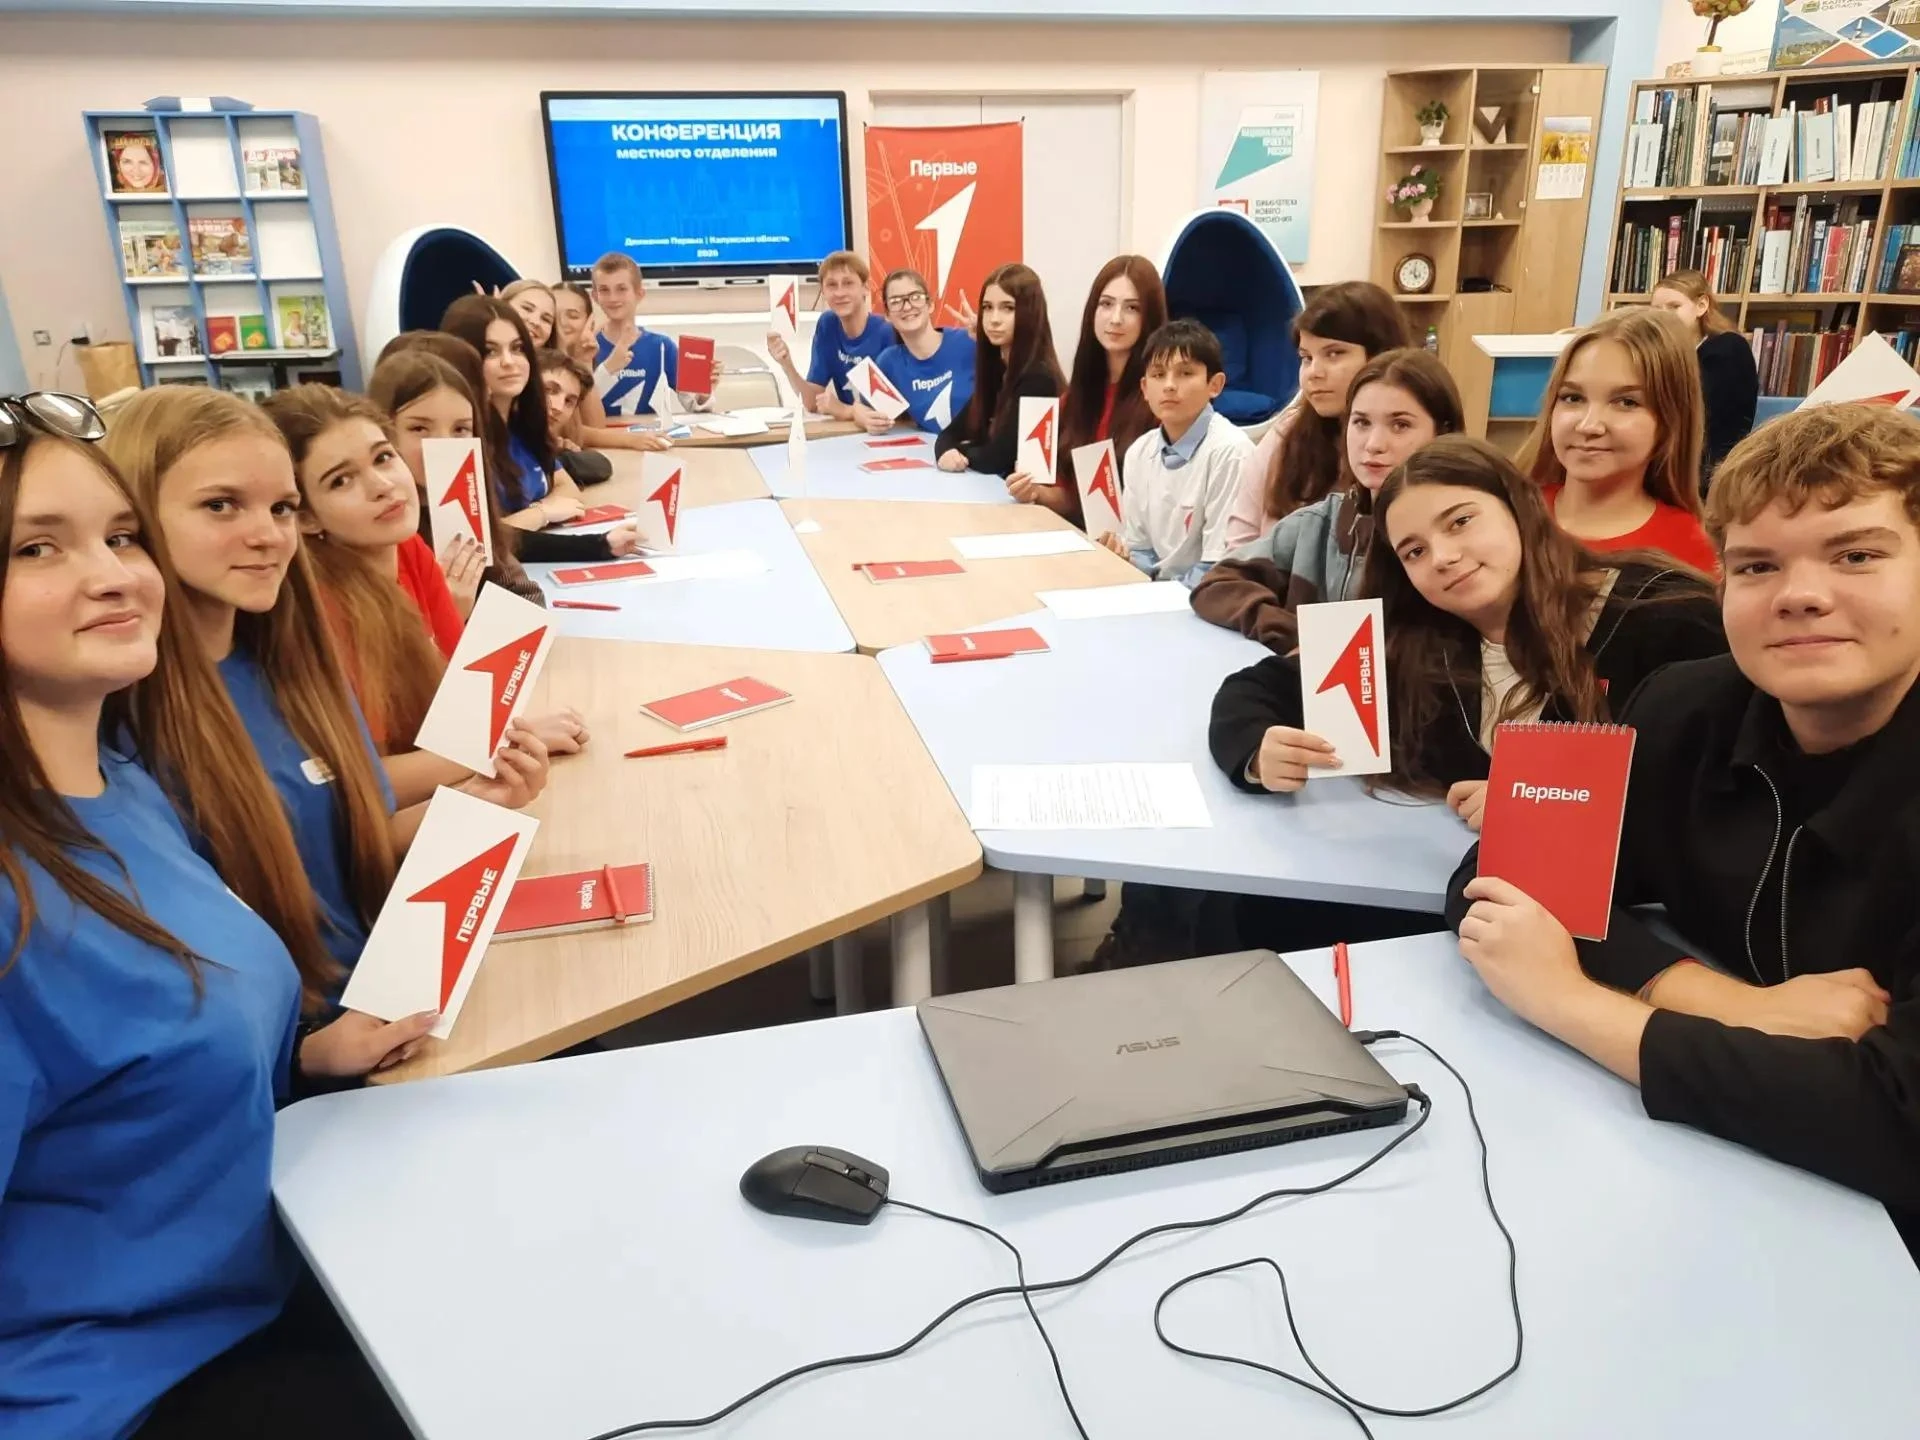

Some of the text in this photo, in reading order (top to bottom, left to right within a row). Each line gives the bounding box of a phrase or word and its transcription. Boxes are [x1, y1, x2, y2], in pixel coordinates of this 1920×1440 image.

[611, 123, 782, 142] КОНФЕРЕНЦИЯ
[616, 147, 778, 160] местного отделения
[909, 159, 978, 181] Первые
[912, 370, 953, 392] Первые
[500, 648, 532, 706] ПЕРВЫЕ
[1359, 645, 1373, 705] ПЕРВЫЕ
[1511, 781, 1591, 805] Первые
[455, 867, 499, 943] ПЕРВЫЕ
[576, 879, 597, 911] Первые
[1116, 1036, 1180, 1055] ASUS
